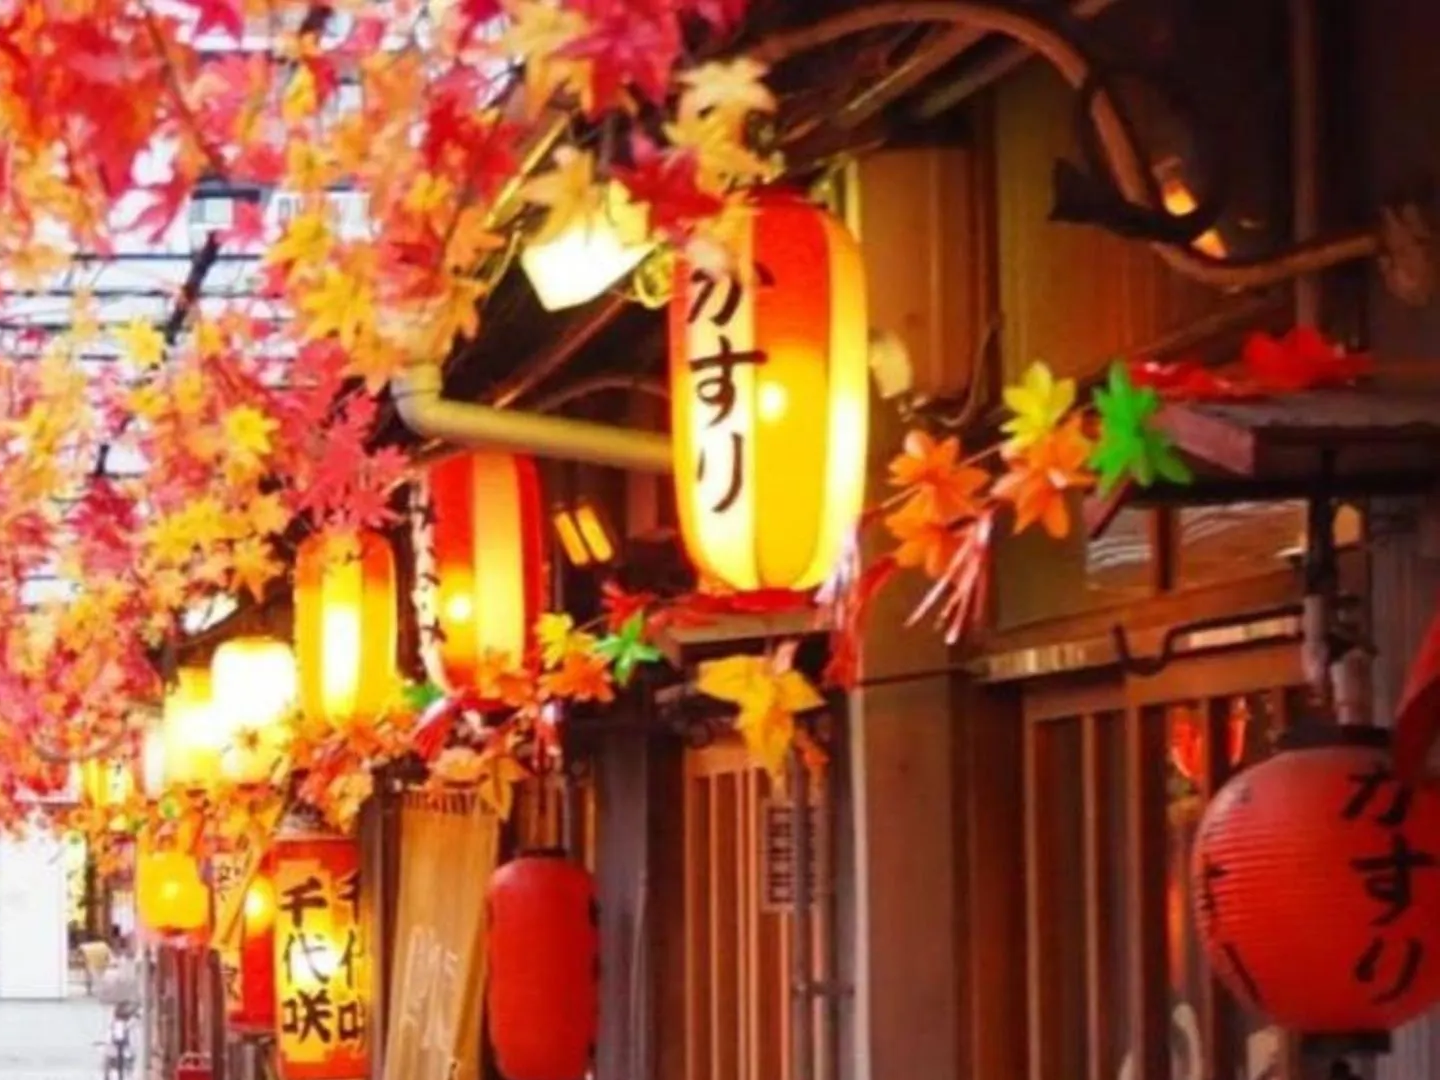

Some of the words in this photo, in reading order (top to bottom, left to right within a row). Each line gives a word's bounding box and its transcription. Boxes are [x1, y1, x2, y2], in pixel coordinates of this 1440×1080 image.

[687, 266, 777, 514] かすり
[279, 875, 332, 1045] 千代咲
[1340, 766, 1439, 1004] かすり
